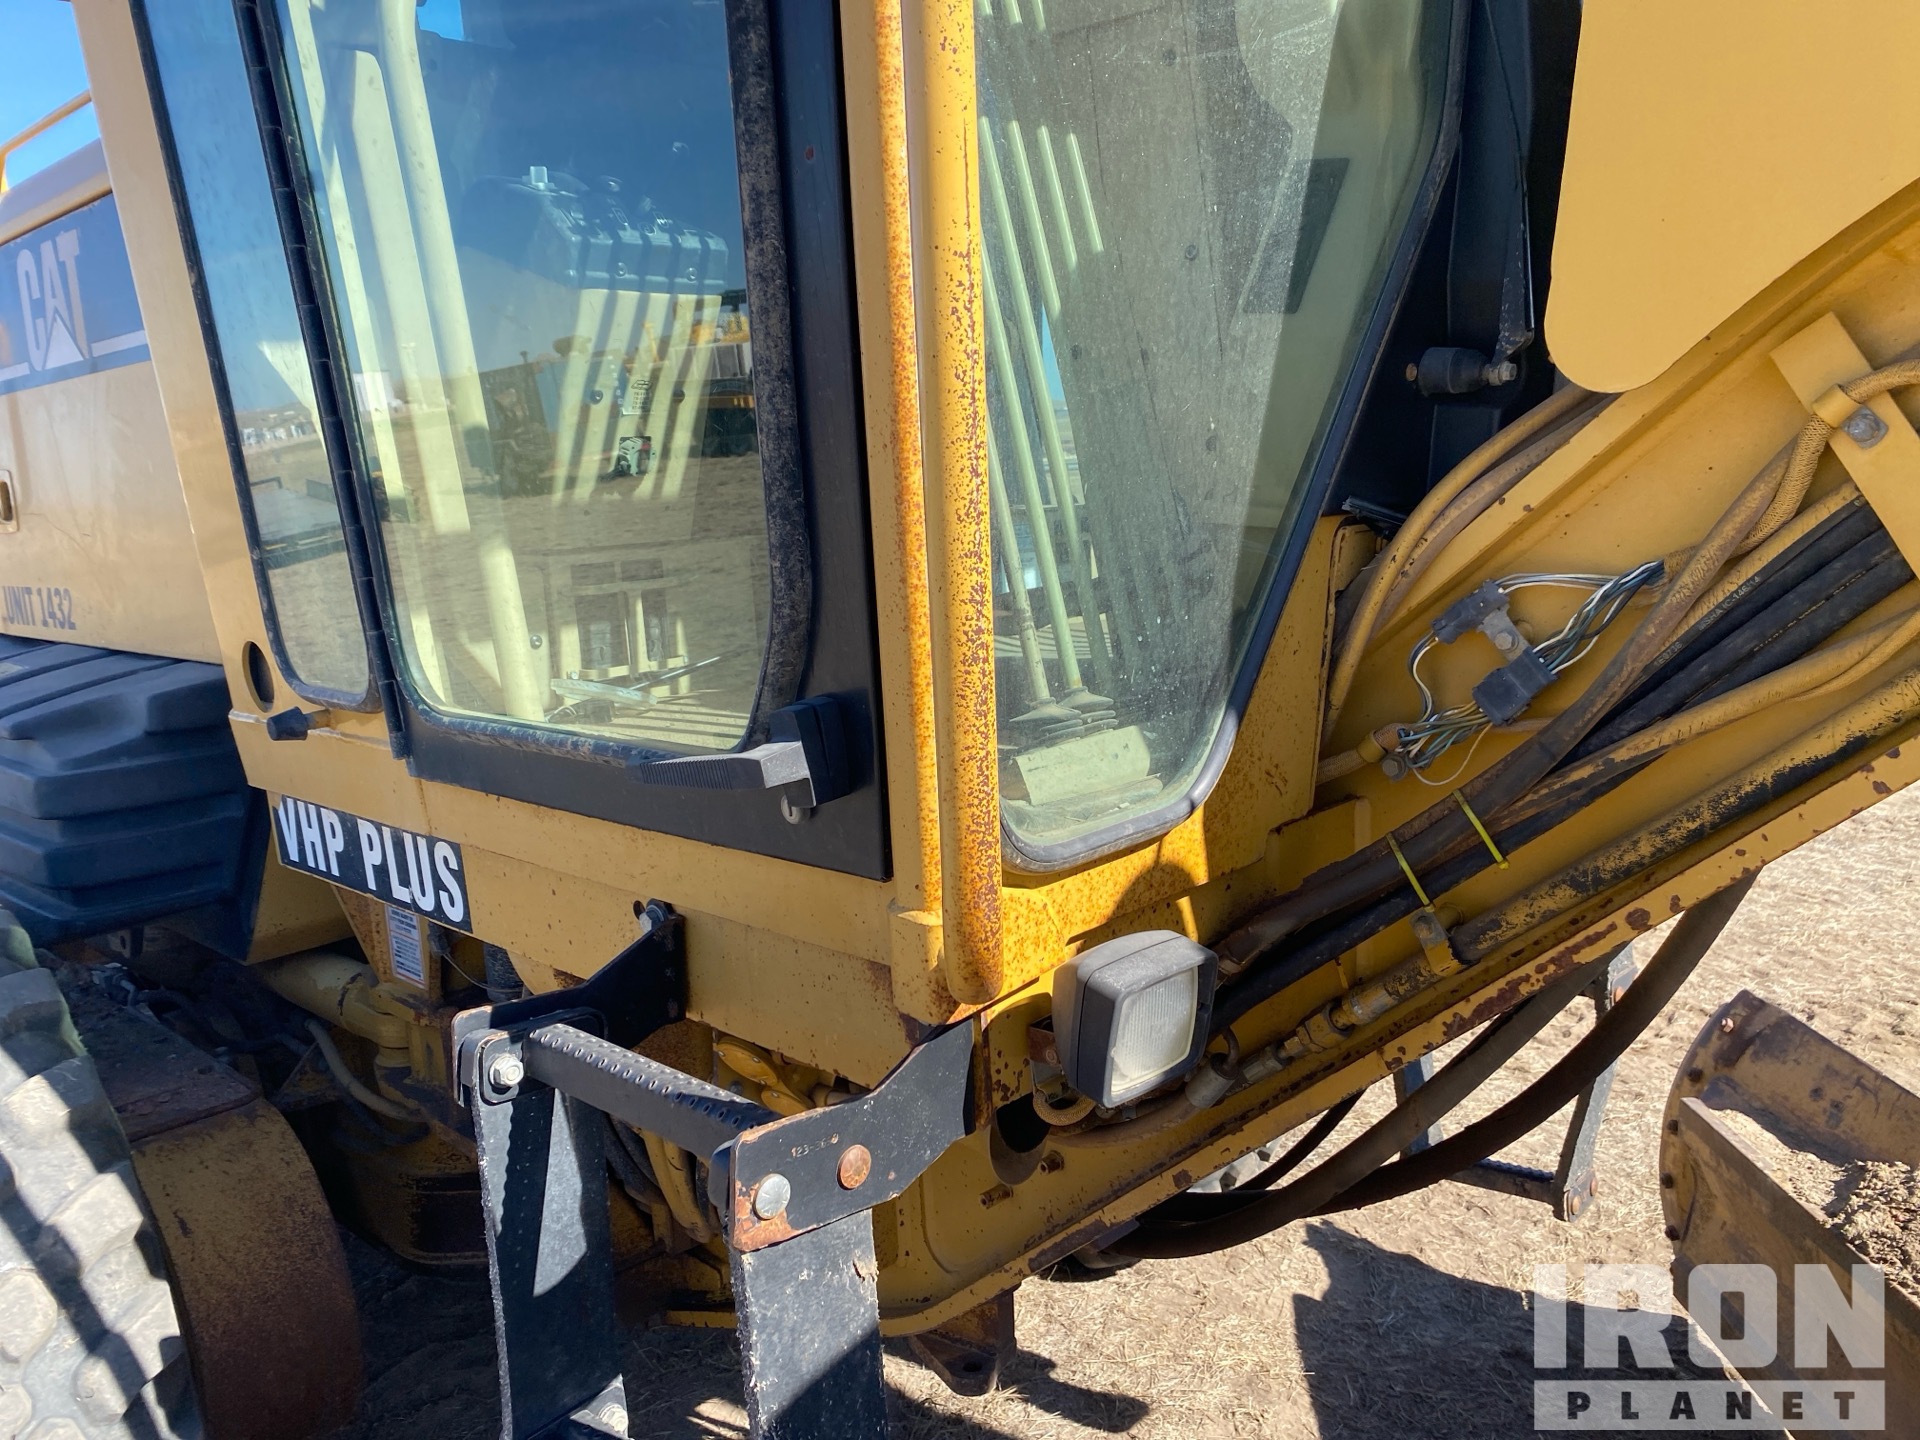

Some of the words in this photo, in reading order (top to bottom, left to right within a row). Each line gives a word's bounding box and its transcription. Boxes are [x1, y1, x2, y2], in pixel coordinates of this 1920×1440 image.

[17, 228, 90, 371] CAT
[36, 587, 76, 630] 1432
[278, 797, 345, 877] VHP
[356, 817, 464, 923] PLUS
